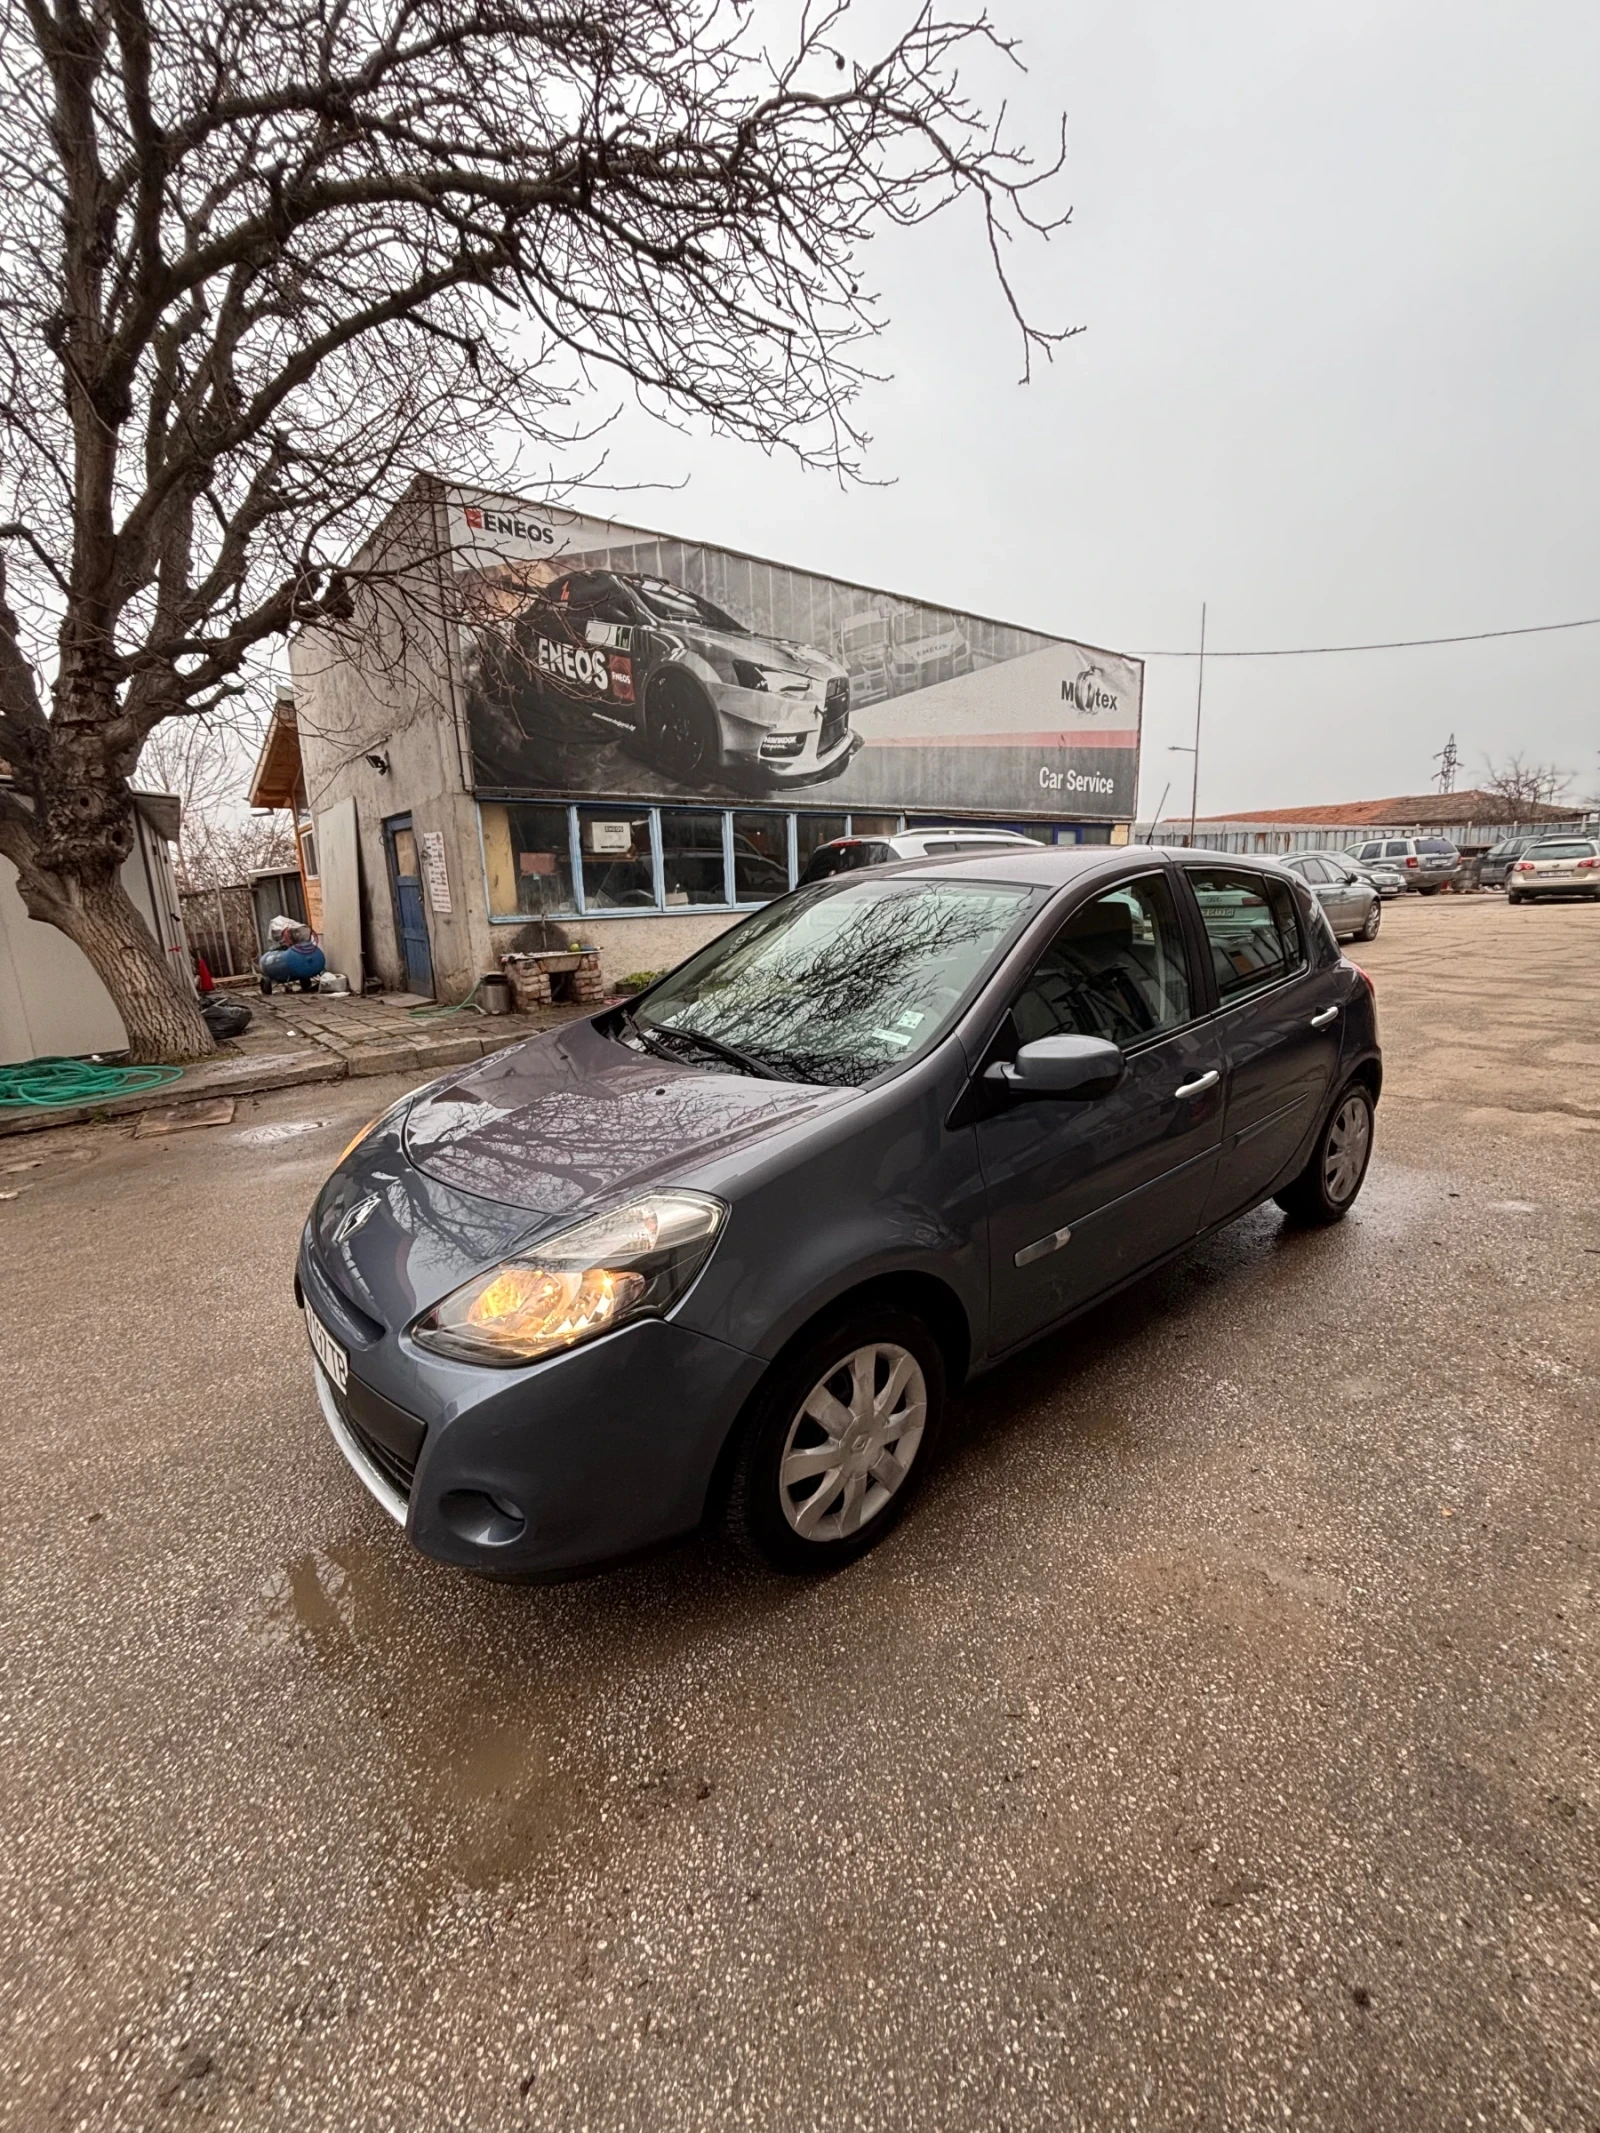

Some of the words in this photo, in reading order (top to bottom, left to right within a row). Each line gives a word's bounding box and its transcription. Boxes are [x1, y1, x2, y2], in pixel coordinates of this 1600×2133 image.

[484, 512, 554, 544] ENEOS
[538, 637, 609, 690] ENEOS
[611, 671, 631, 684] ENEOS
[1039, 766, 1063, 789] Car
[1066, 769, 1114, 794] Service
